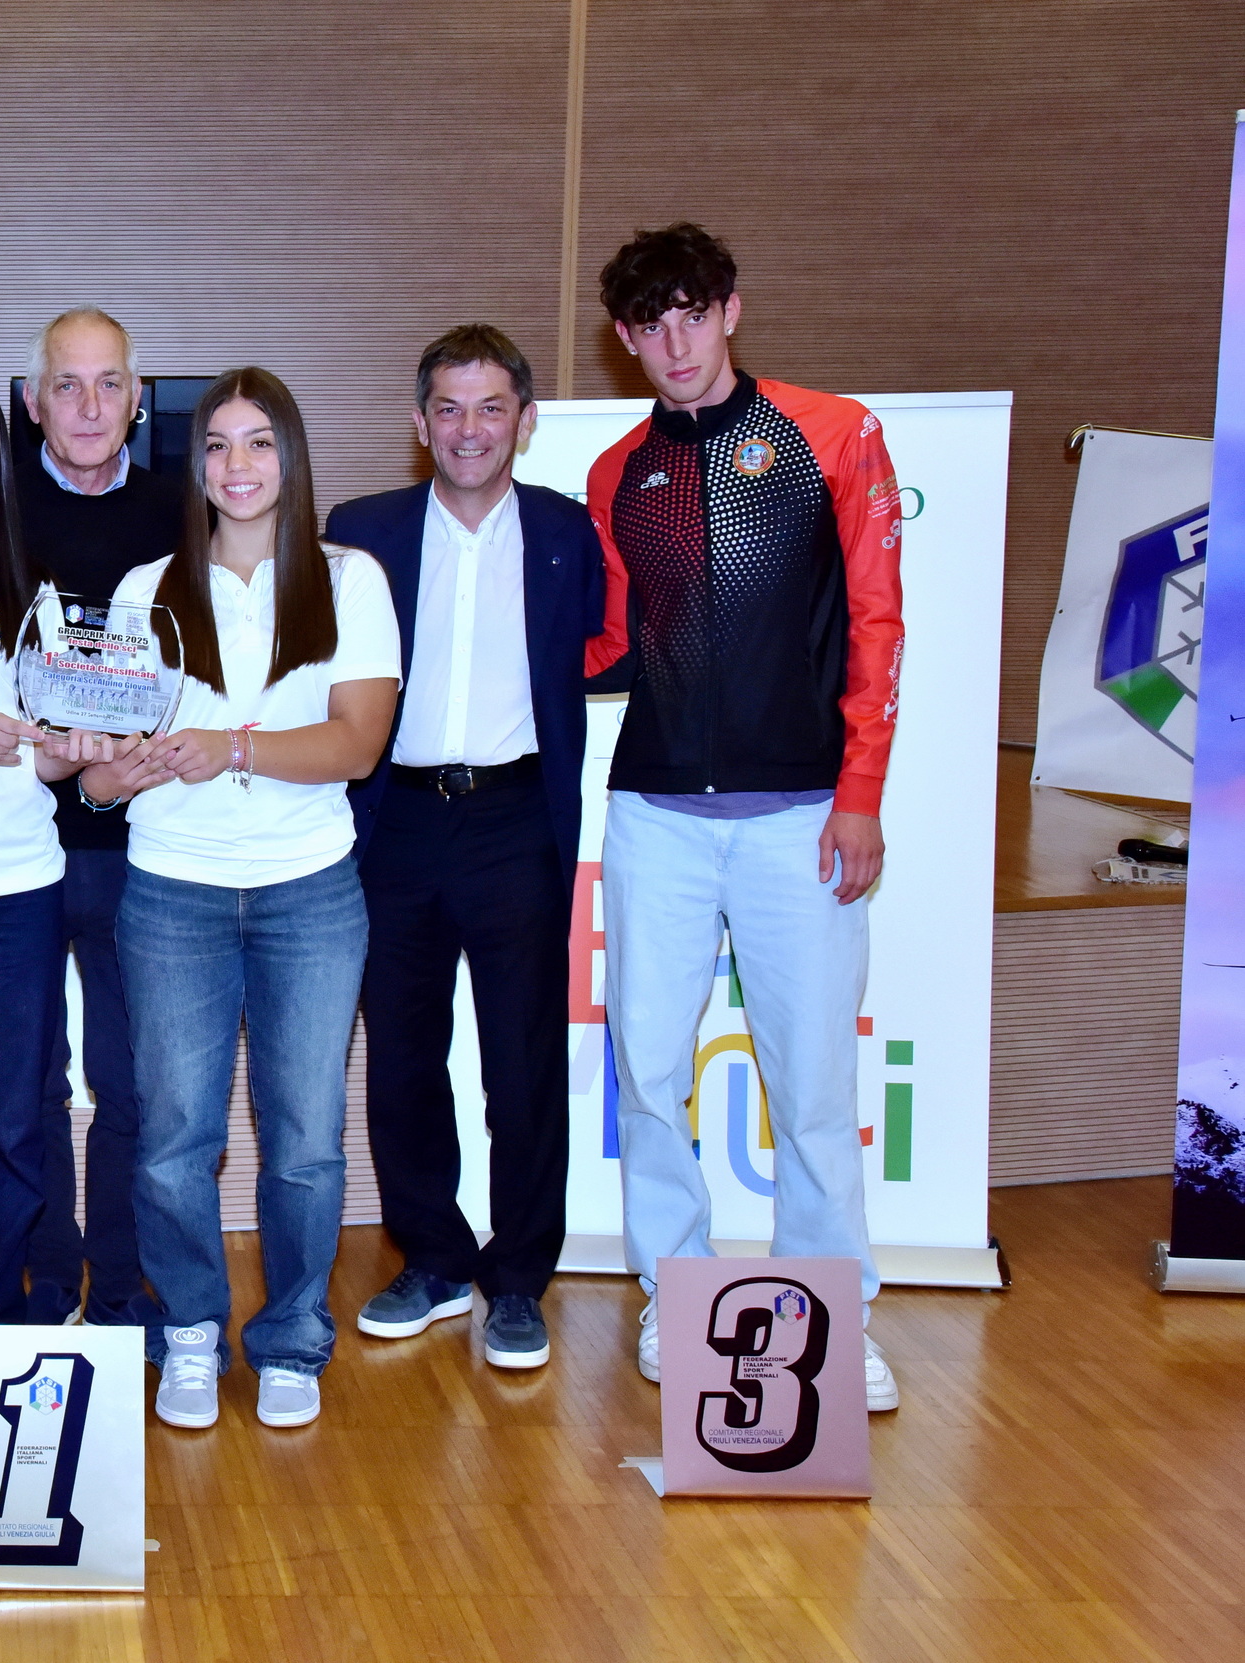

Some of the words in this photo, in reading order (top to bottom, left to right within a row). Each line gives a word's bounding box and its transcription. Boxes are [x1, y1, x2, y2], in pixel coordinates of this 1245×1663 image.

[58, 626, 82, 636] GRAN
[84, 630, 104, 639] PRIX
[106, 633, 123, 642] FVG
[125, 635, 149, 645] 2025
[68, 637, 93, 647] festa
[95, 641, 120, 650] dello
[121, 645, 137, 653] sci
[58, 659, 96, 672] Società
[97, 665, 157, 680] Classificata
[42, 671, 82, 683] Categoria
[97, 678, 123, 688] Alpino
[124, 681, 155, 692] Giovani
[779, 1290, 801, 1301] FISI
[35, 1378, 57, 1389] FISI
[695, 1276, 830, 1474] 3
